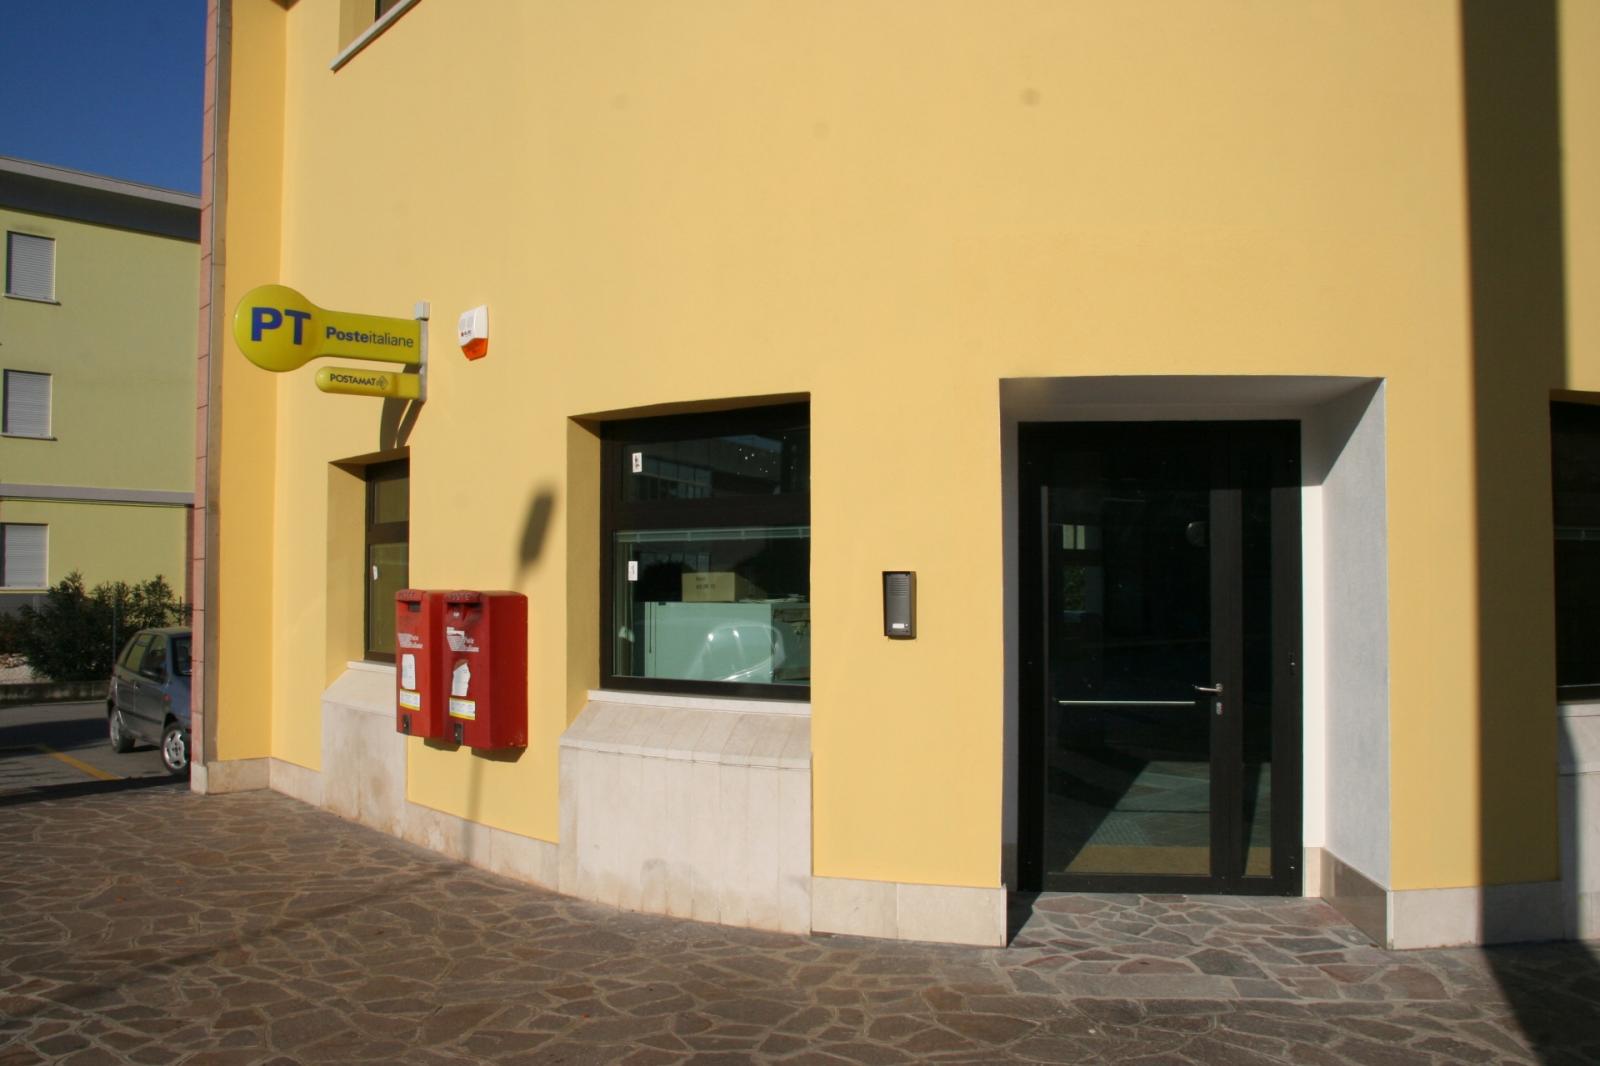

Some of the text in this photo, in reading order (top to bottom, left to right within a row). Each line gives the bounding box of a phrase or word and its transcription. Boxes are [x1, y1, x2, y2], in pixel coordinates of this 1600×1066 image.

[251, 307, 311, 345] PT
[326, 327, 414, 348] Posteitaliane
[330, 374, 377, 386] POSTAMAT
